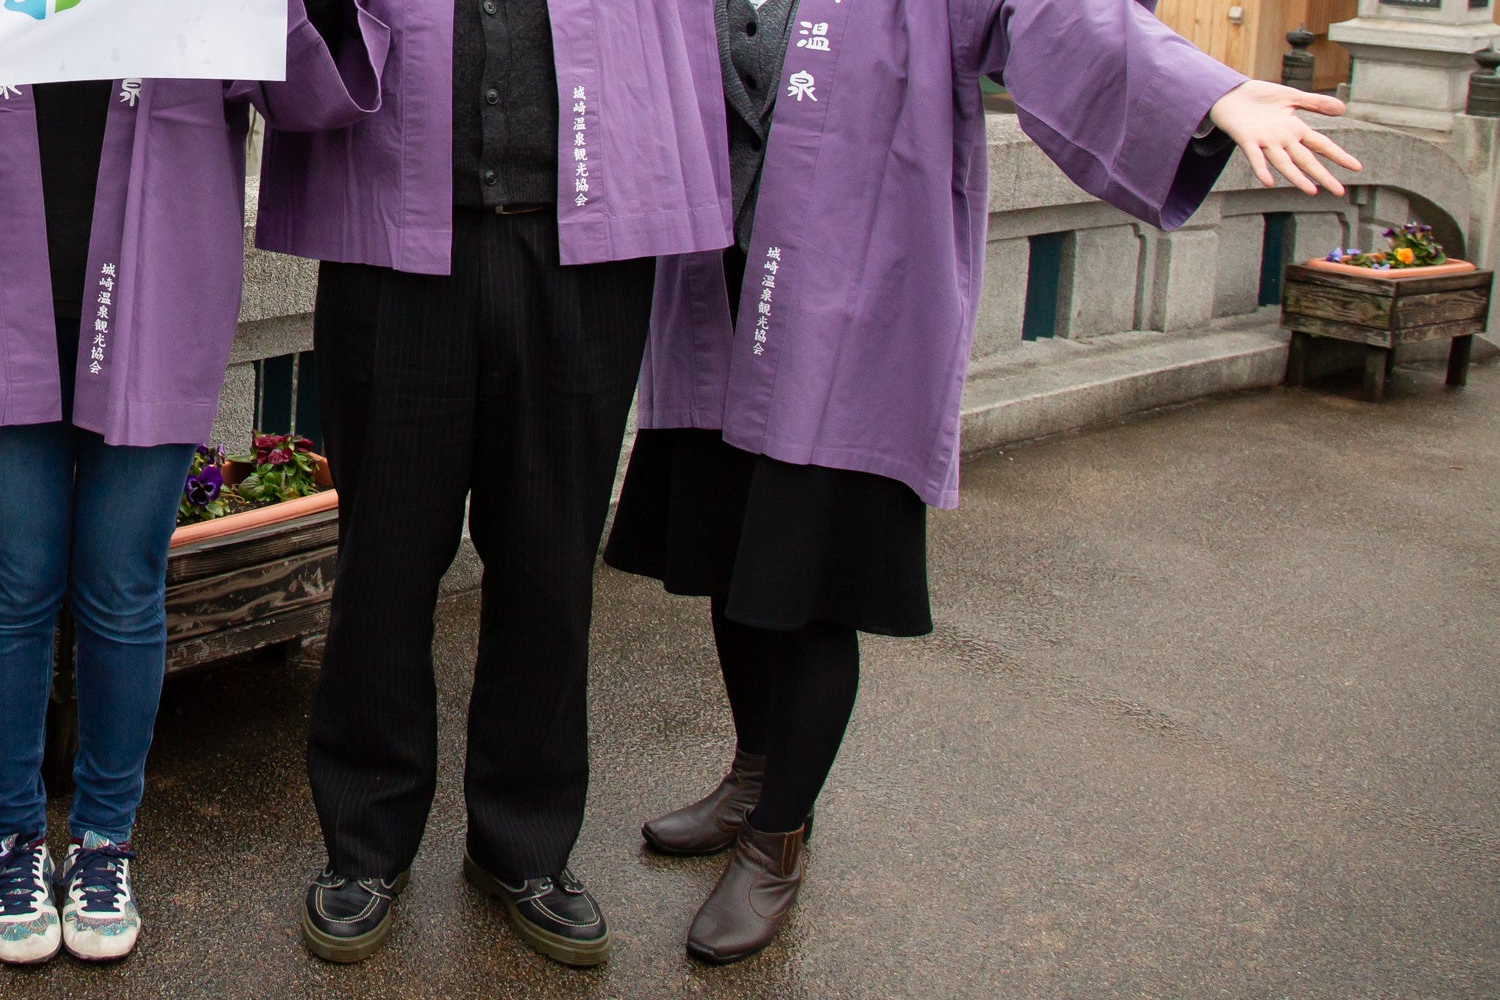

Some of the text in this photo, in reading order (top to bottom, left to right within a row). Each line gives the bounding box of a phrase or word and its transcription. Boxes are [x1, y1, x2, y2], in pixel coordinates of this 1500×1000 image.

[572, 85, 589, 207] 城崎温泉観光協会
[89, 262, 116, 375] 城崎温泉観光協会
[752, 246, 781, 356] 城崎温泉観光協会
